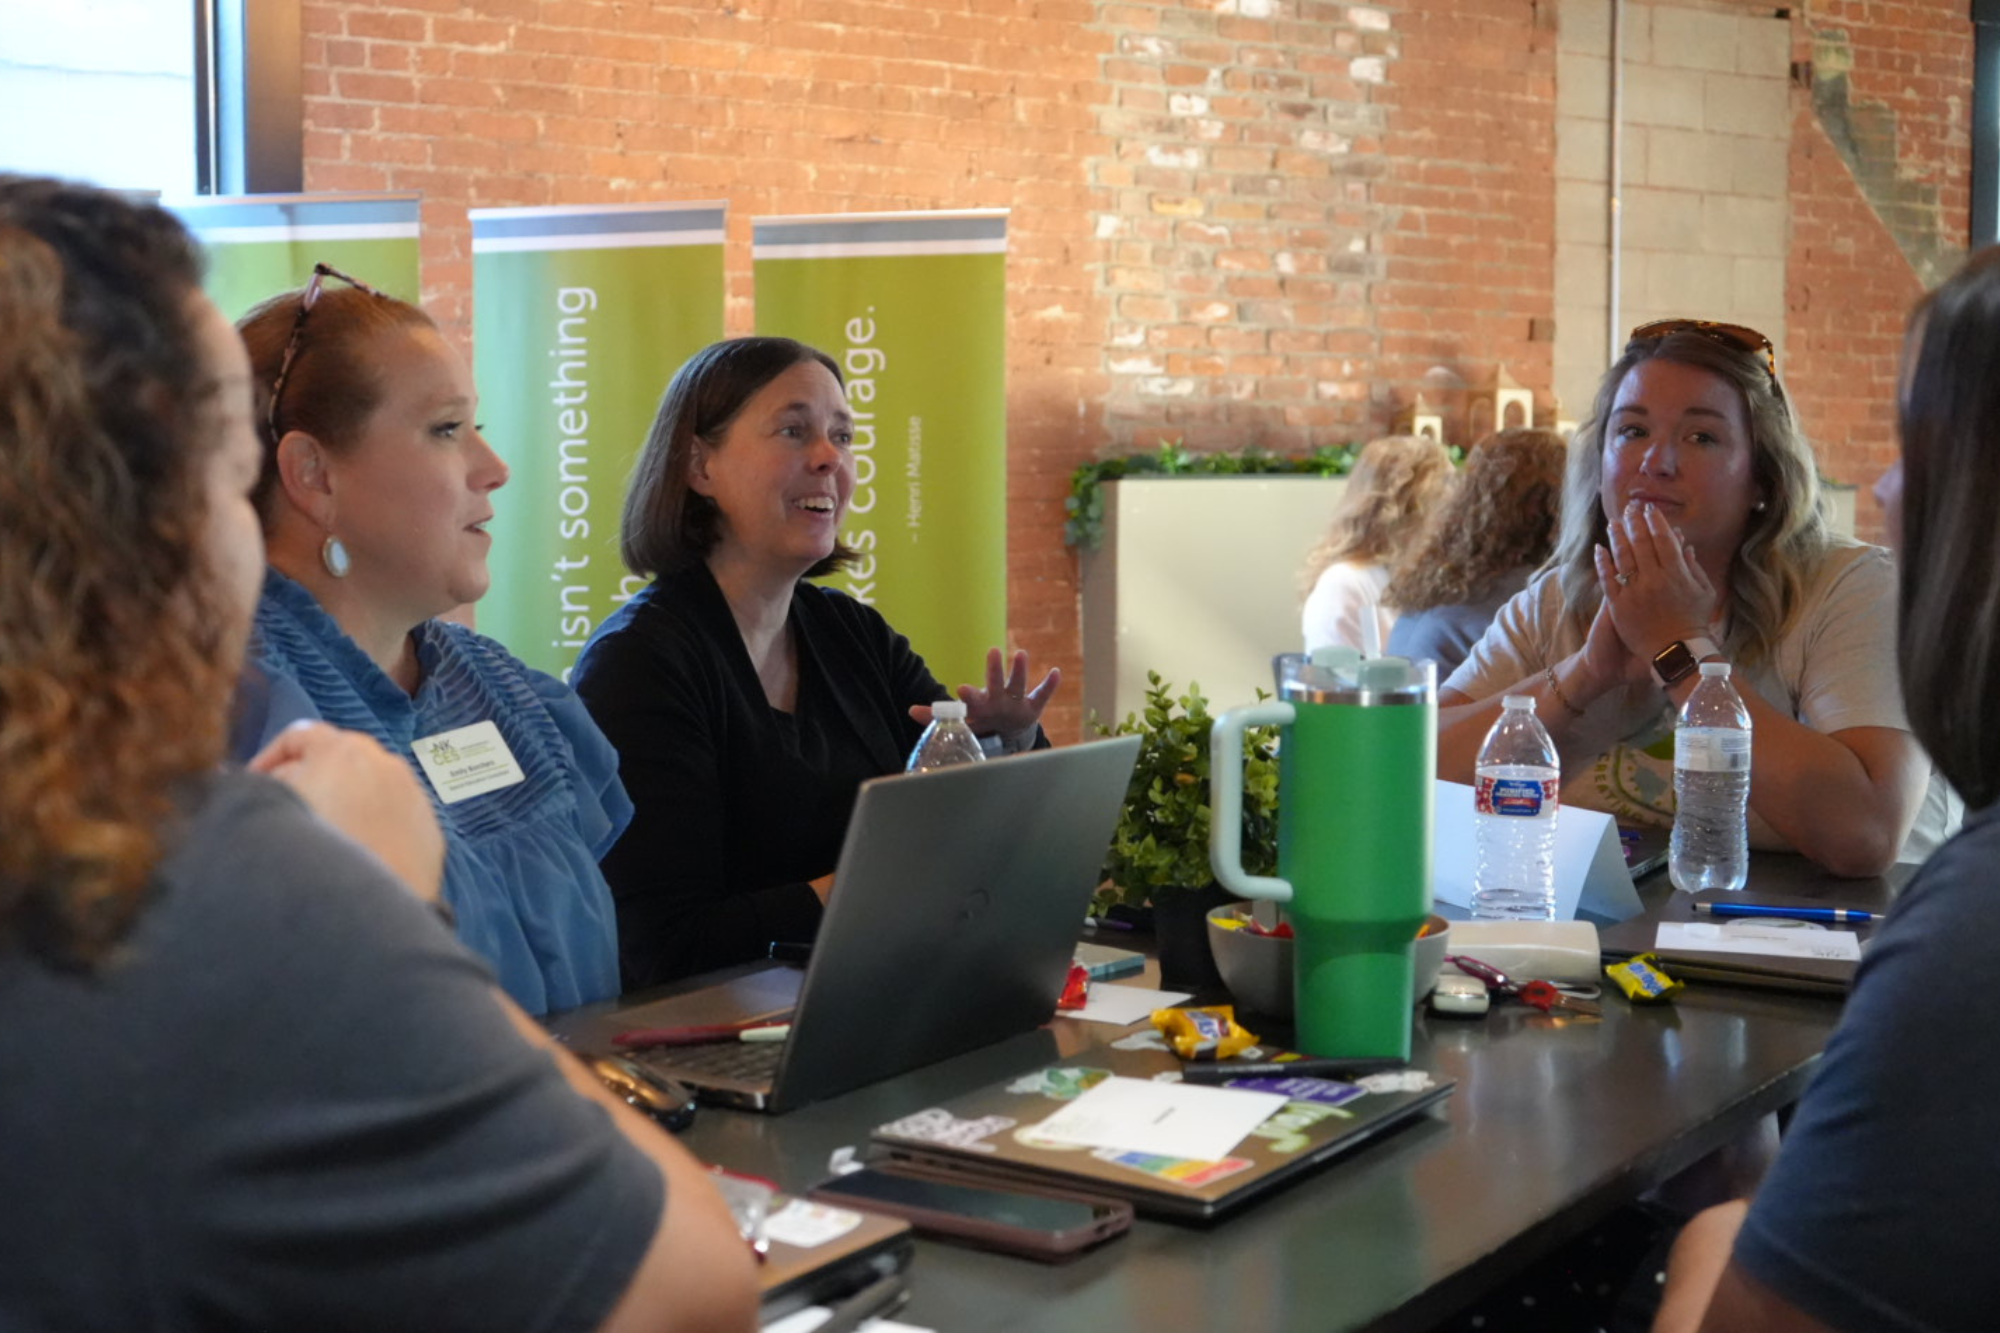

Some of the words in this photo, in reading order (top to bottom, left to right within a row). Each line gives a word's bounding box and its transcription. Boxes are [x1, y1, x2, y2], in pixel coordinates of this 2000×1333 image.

[549, 286, 597, 540] something
[843, 305, 887, 514] courage.
[908, 415, 922, 481] Matisse
[908, 487, 922, 529] Henri
[844, 530, 878, 606] kes
